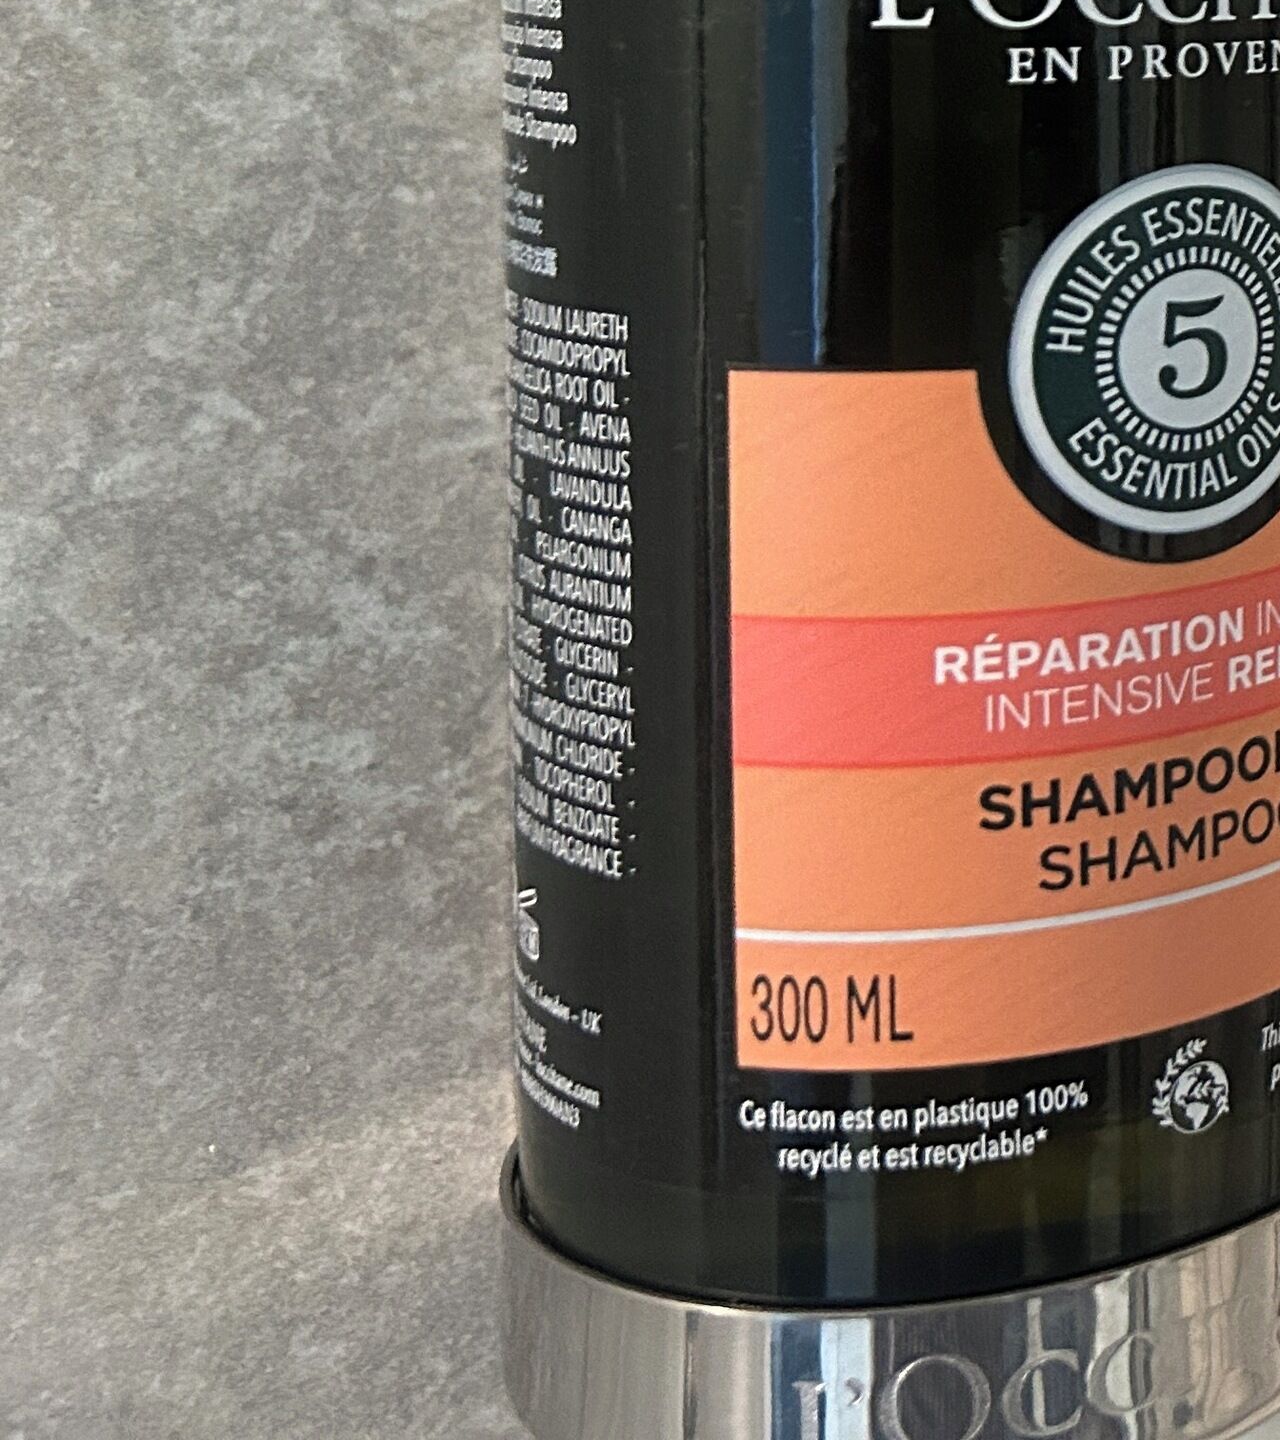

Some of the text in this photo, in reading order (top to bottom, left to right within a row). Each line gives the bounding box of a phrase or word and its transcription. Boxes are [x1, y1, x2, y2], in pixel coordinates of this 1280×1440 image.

[1007, 46, 1082, 85] EN
[1044, 224, 1141, 353] HUILES
[565, 307, 629, 342] LAURETH
[1158, 294, 1229, 399] 5
[555, 371, 589, 404] ROOT
[592, 378, 620, 409] OIL
[580, 410, 632, 445] AVENA
[1067, 417, 1238, 500] ESSENTIAL
[550, 470, 632, 512] LAVANDULA
[561, 505, 633, 547] CANANGA
[934, 606, 1245, 686] RÉPARATION
[985, 662, 1216, 734] INTENSIVE
[555, 734, 623, 782] CHLORIDE
[581, 1007, 602, 1036] UK
[750, 973, 915, 1044] 300 ML
[738, 1079, 1090, 1136] Ce flacon est en plastique 100%
[777, 1141, 851, 1177] recyclé
[857, 1144, 881, 1170] et
[884, 1144, 918, 1169] est
